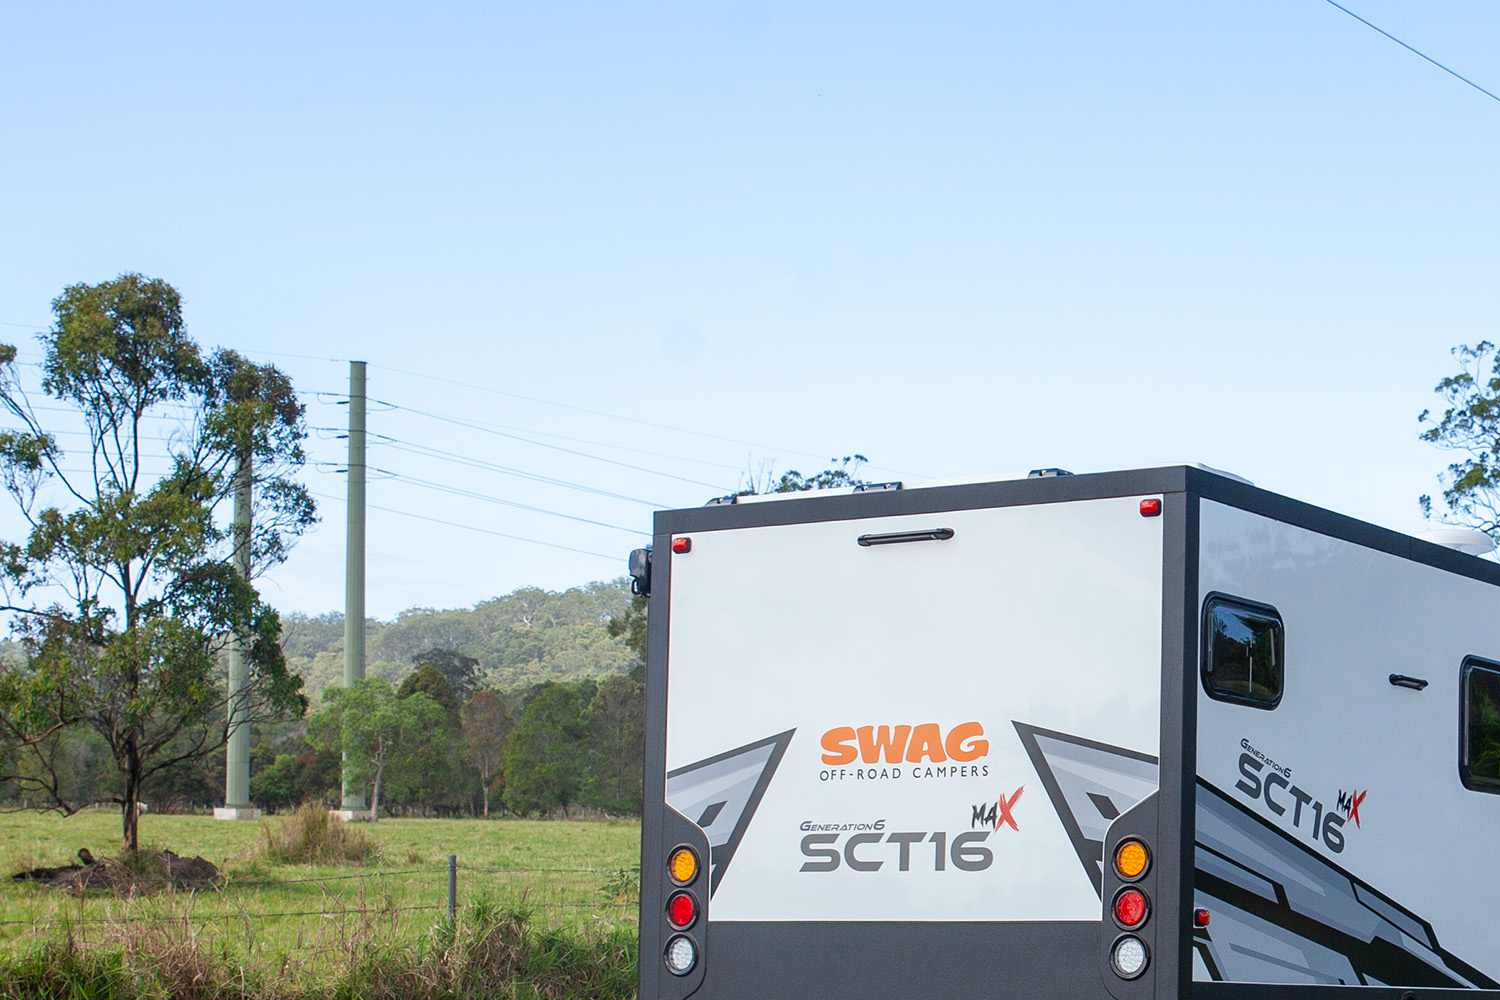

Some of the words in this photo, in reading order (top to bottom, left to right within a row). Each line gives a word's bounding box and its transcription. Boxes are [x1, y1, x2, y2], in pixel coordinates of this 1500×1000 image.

[820, 721, 989, 766] SWAG
[819, 767, 902, 782] OFF-ROAD
[912, 765, 989, 779] CAMPERS
[971, 784, 1026, 834] MAX
[1235, 752, 1346, 854] SCT16
[1336, 789, 1368, 829] MAX
[799, 831, 994, 873] SCT16
